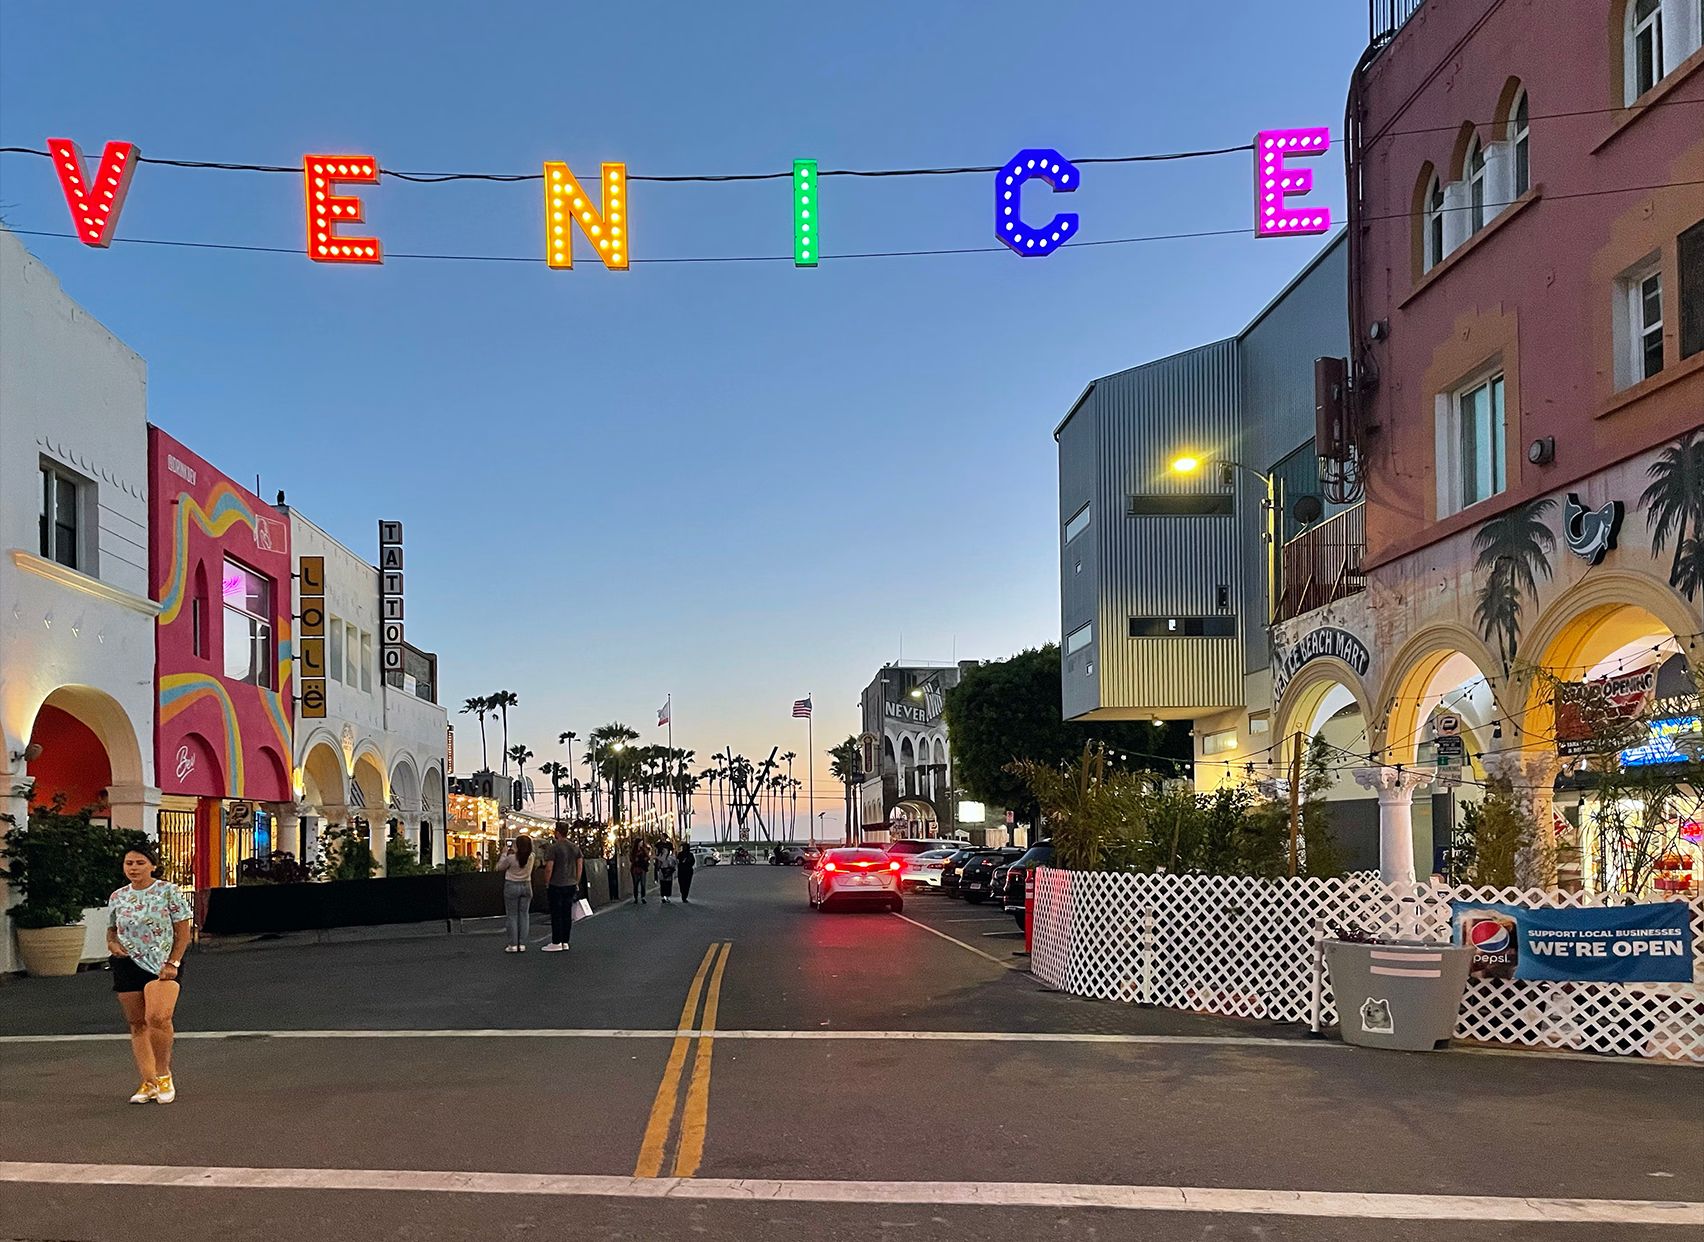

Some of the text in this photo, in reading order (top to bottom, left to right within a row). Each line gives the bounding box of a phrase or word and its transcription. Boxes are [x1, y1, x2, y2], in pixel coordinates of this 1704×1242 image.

[47, 127, 1332, 271] VENICE
[384, 524, 399, 667] TATTOO
[1299, 630, 1333, 661] BEACH
[1335, 632, 1366, 673] MART
[1602, 672, 1654, 697] OPENING
[885, 701, 926, 721] NEVER
[1528, 928, 1682, 938] SUPPORT LOCAL BUSINESSES
[1473, 953, 1508, 964] pepsi
[1529, 940, 1683, 957] WE'RE OPEN
